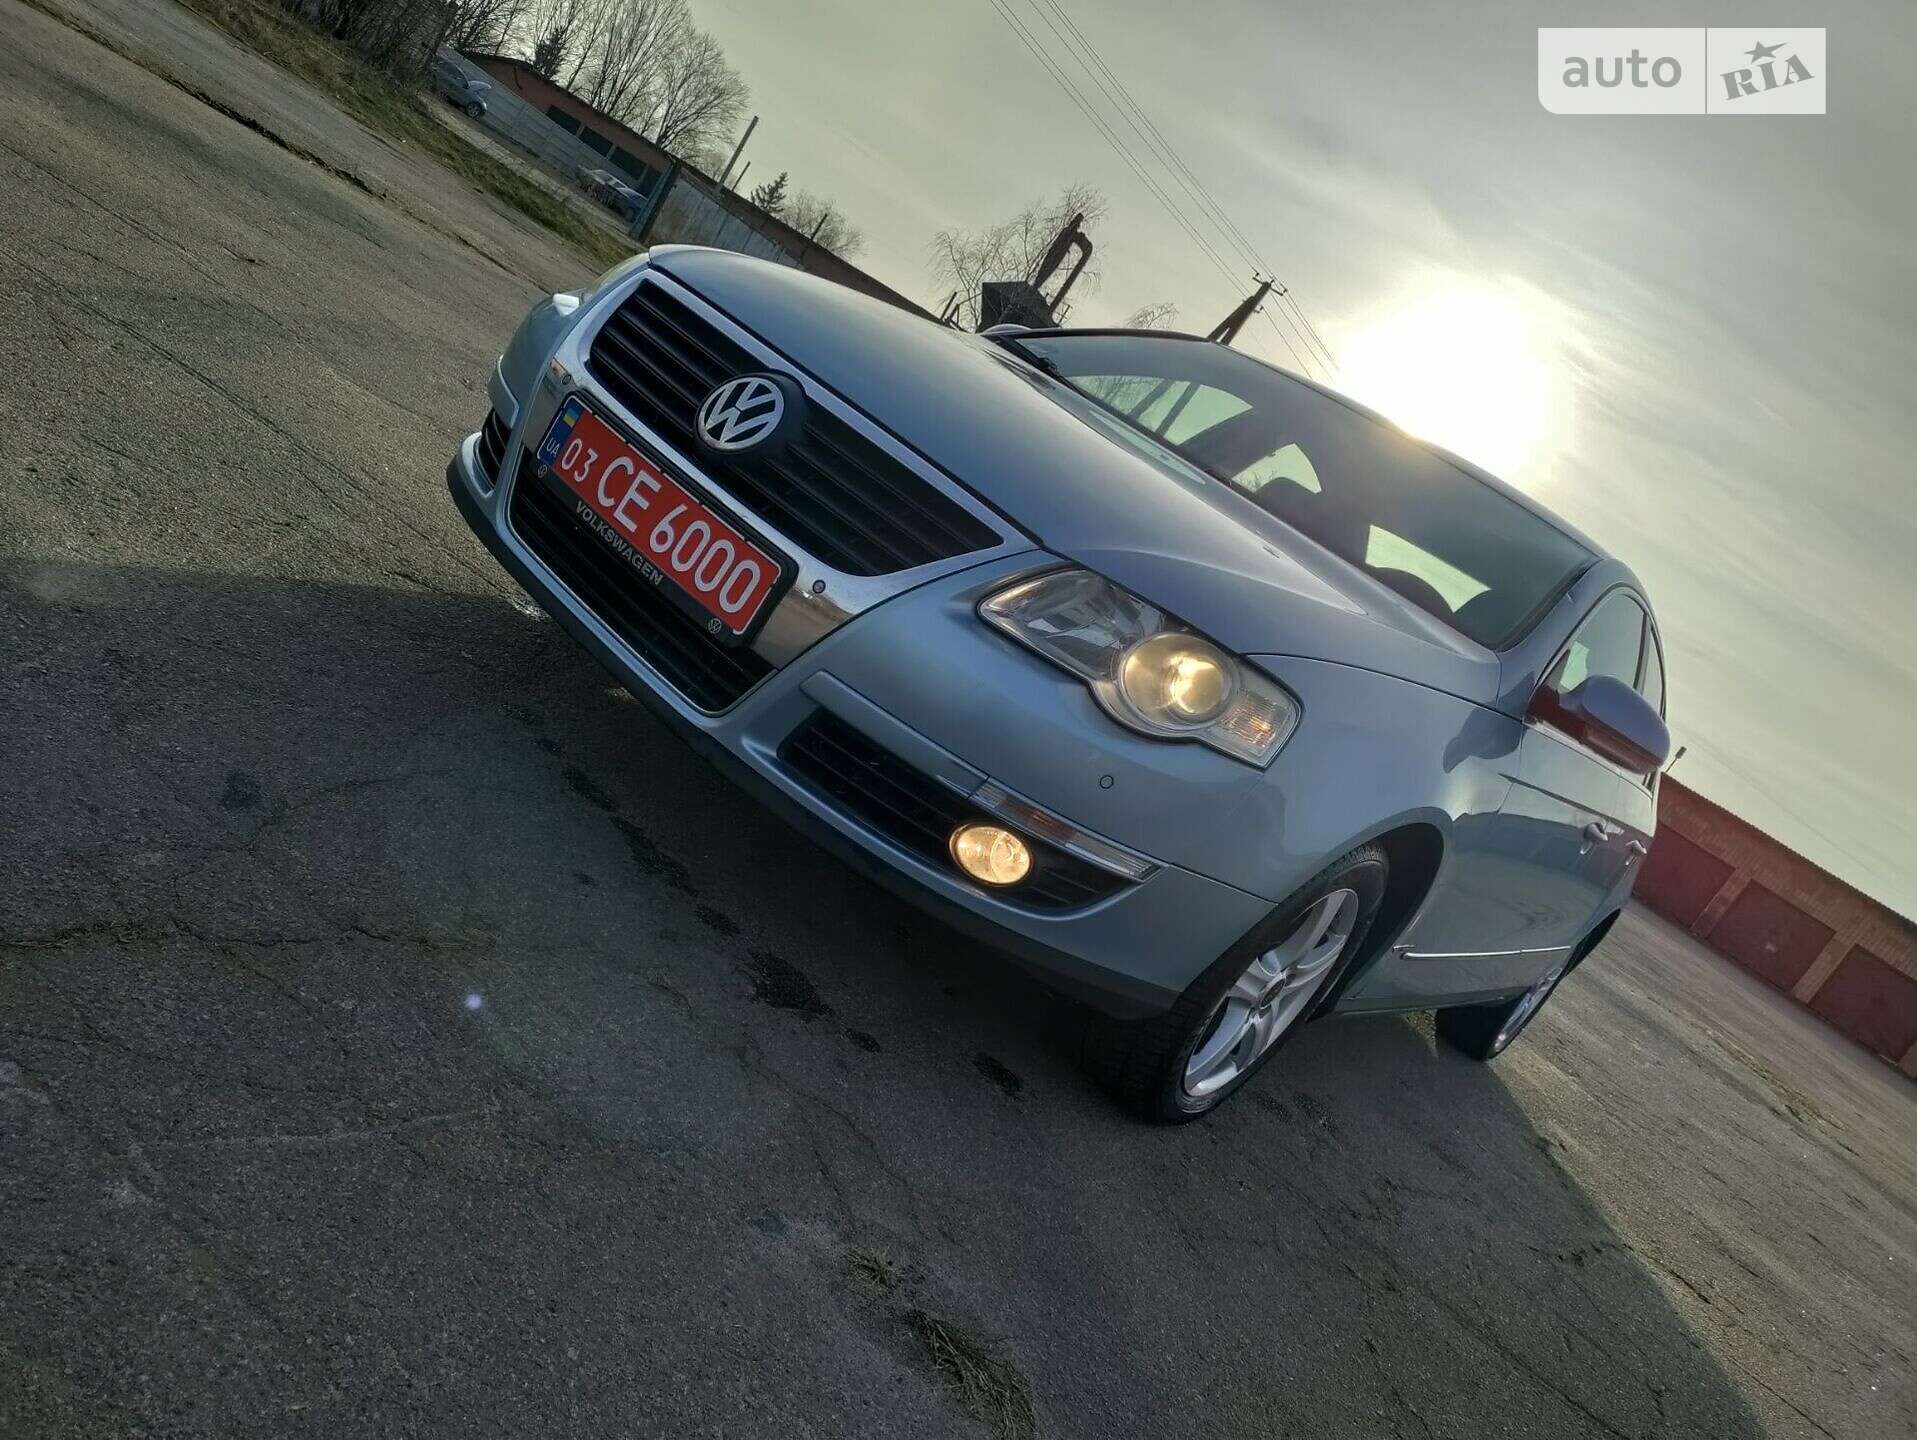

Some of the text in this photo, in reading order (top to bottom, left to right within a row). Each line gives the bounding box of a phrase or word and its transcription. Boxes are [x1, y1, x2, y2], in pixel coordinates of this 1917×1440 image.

[546, 437, 560, 457] UA
[699, 376, 785, 450] VW
[561, 438, 761, 613] 03 CE 6000
[575, 501, 664, 586] VOLKSWAGEN
